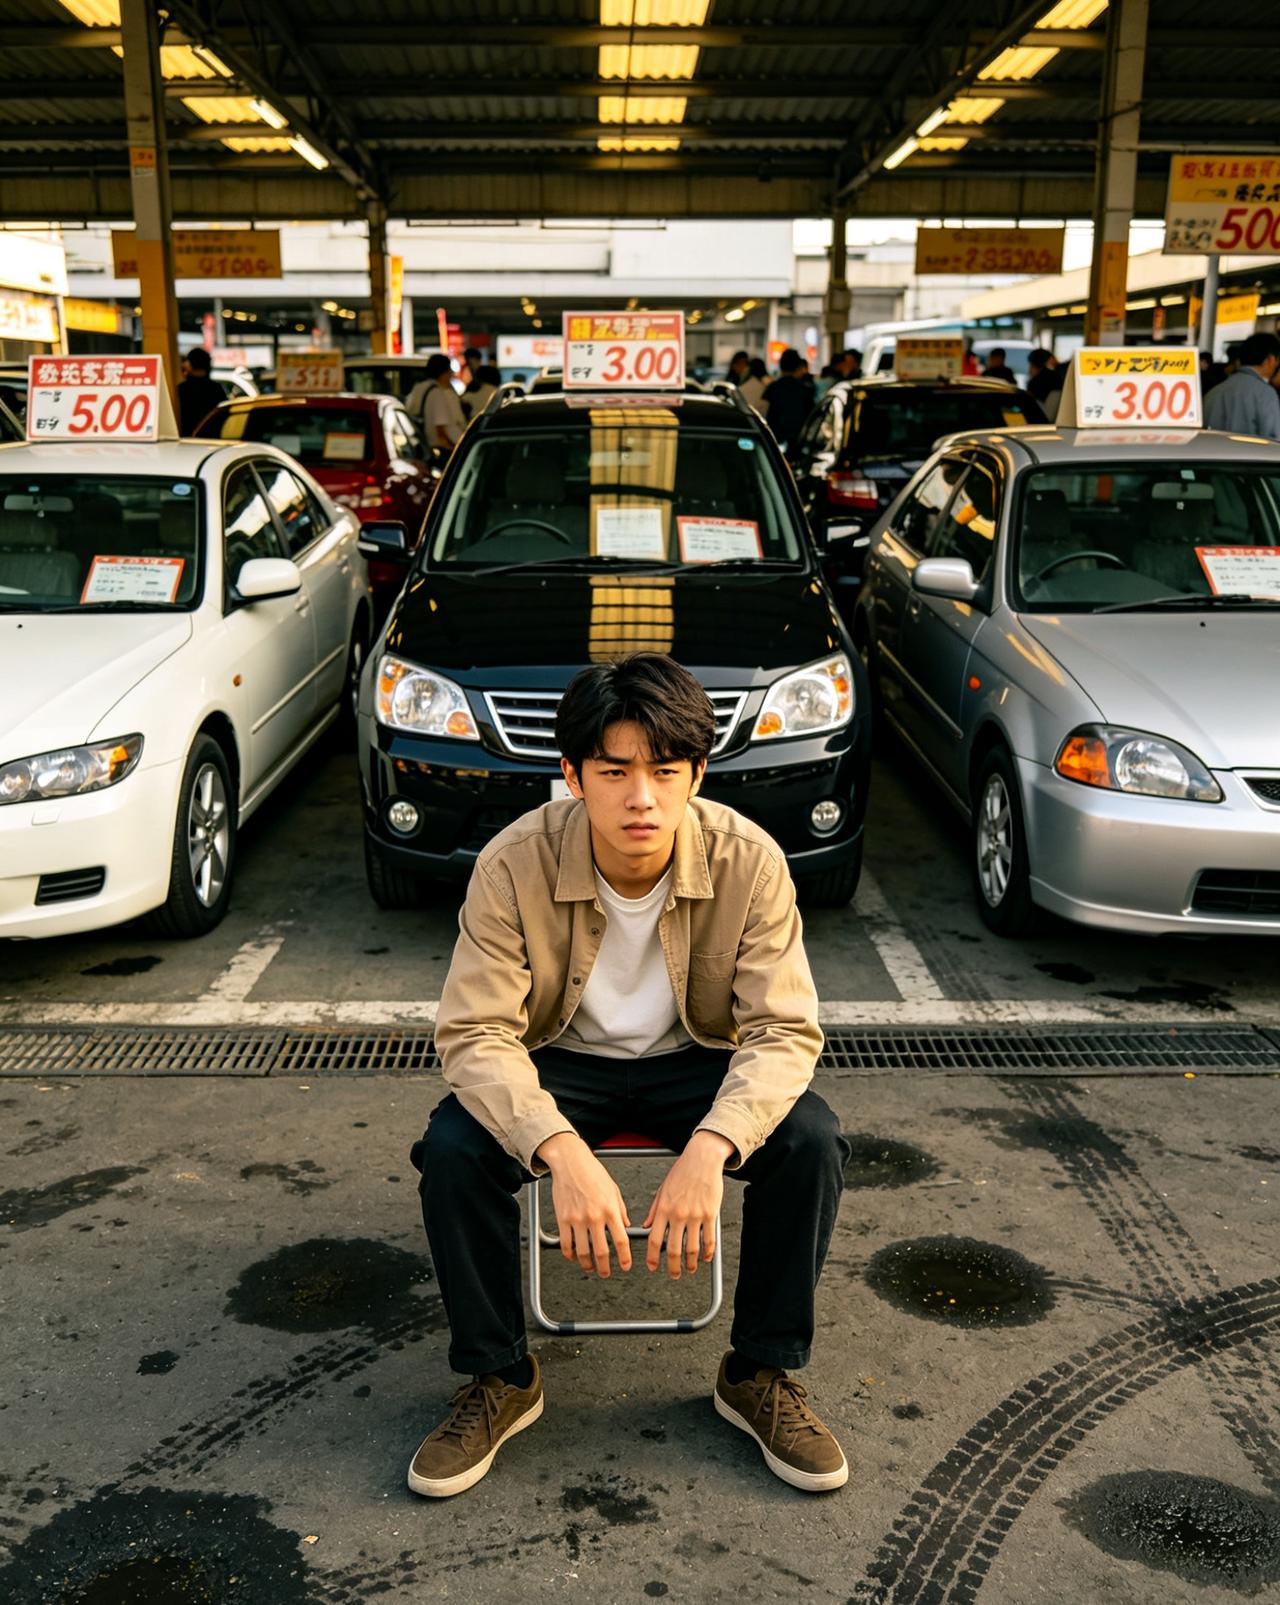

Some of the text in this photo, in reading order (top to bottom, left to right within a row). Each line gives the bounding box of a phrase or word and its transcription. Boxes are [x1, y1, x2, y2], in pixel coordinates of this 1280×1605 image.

[602, 346, 677, 382] 3.00
[68, 394, 151, 434] 5.00
[1112, 381, 1192, 420] 3.00
